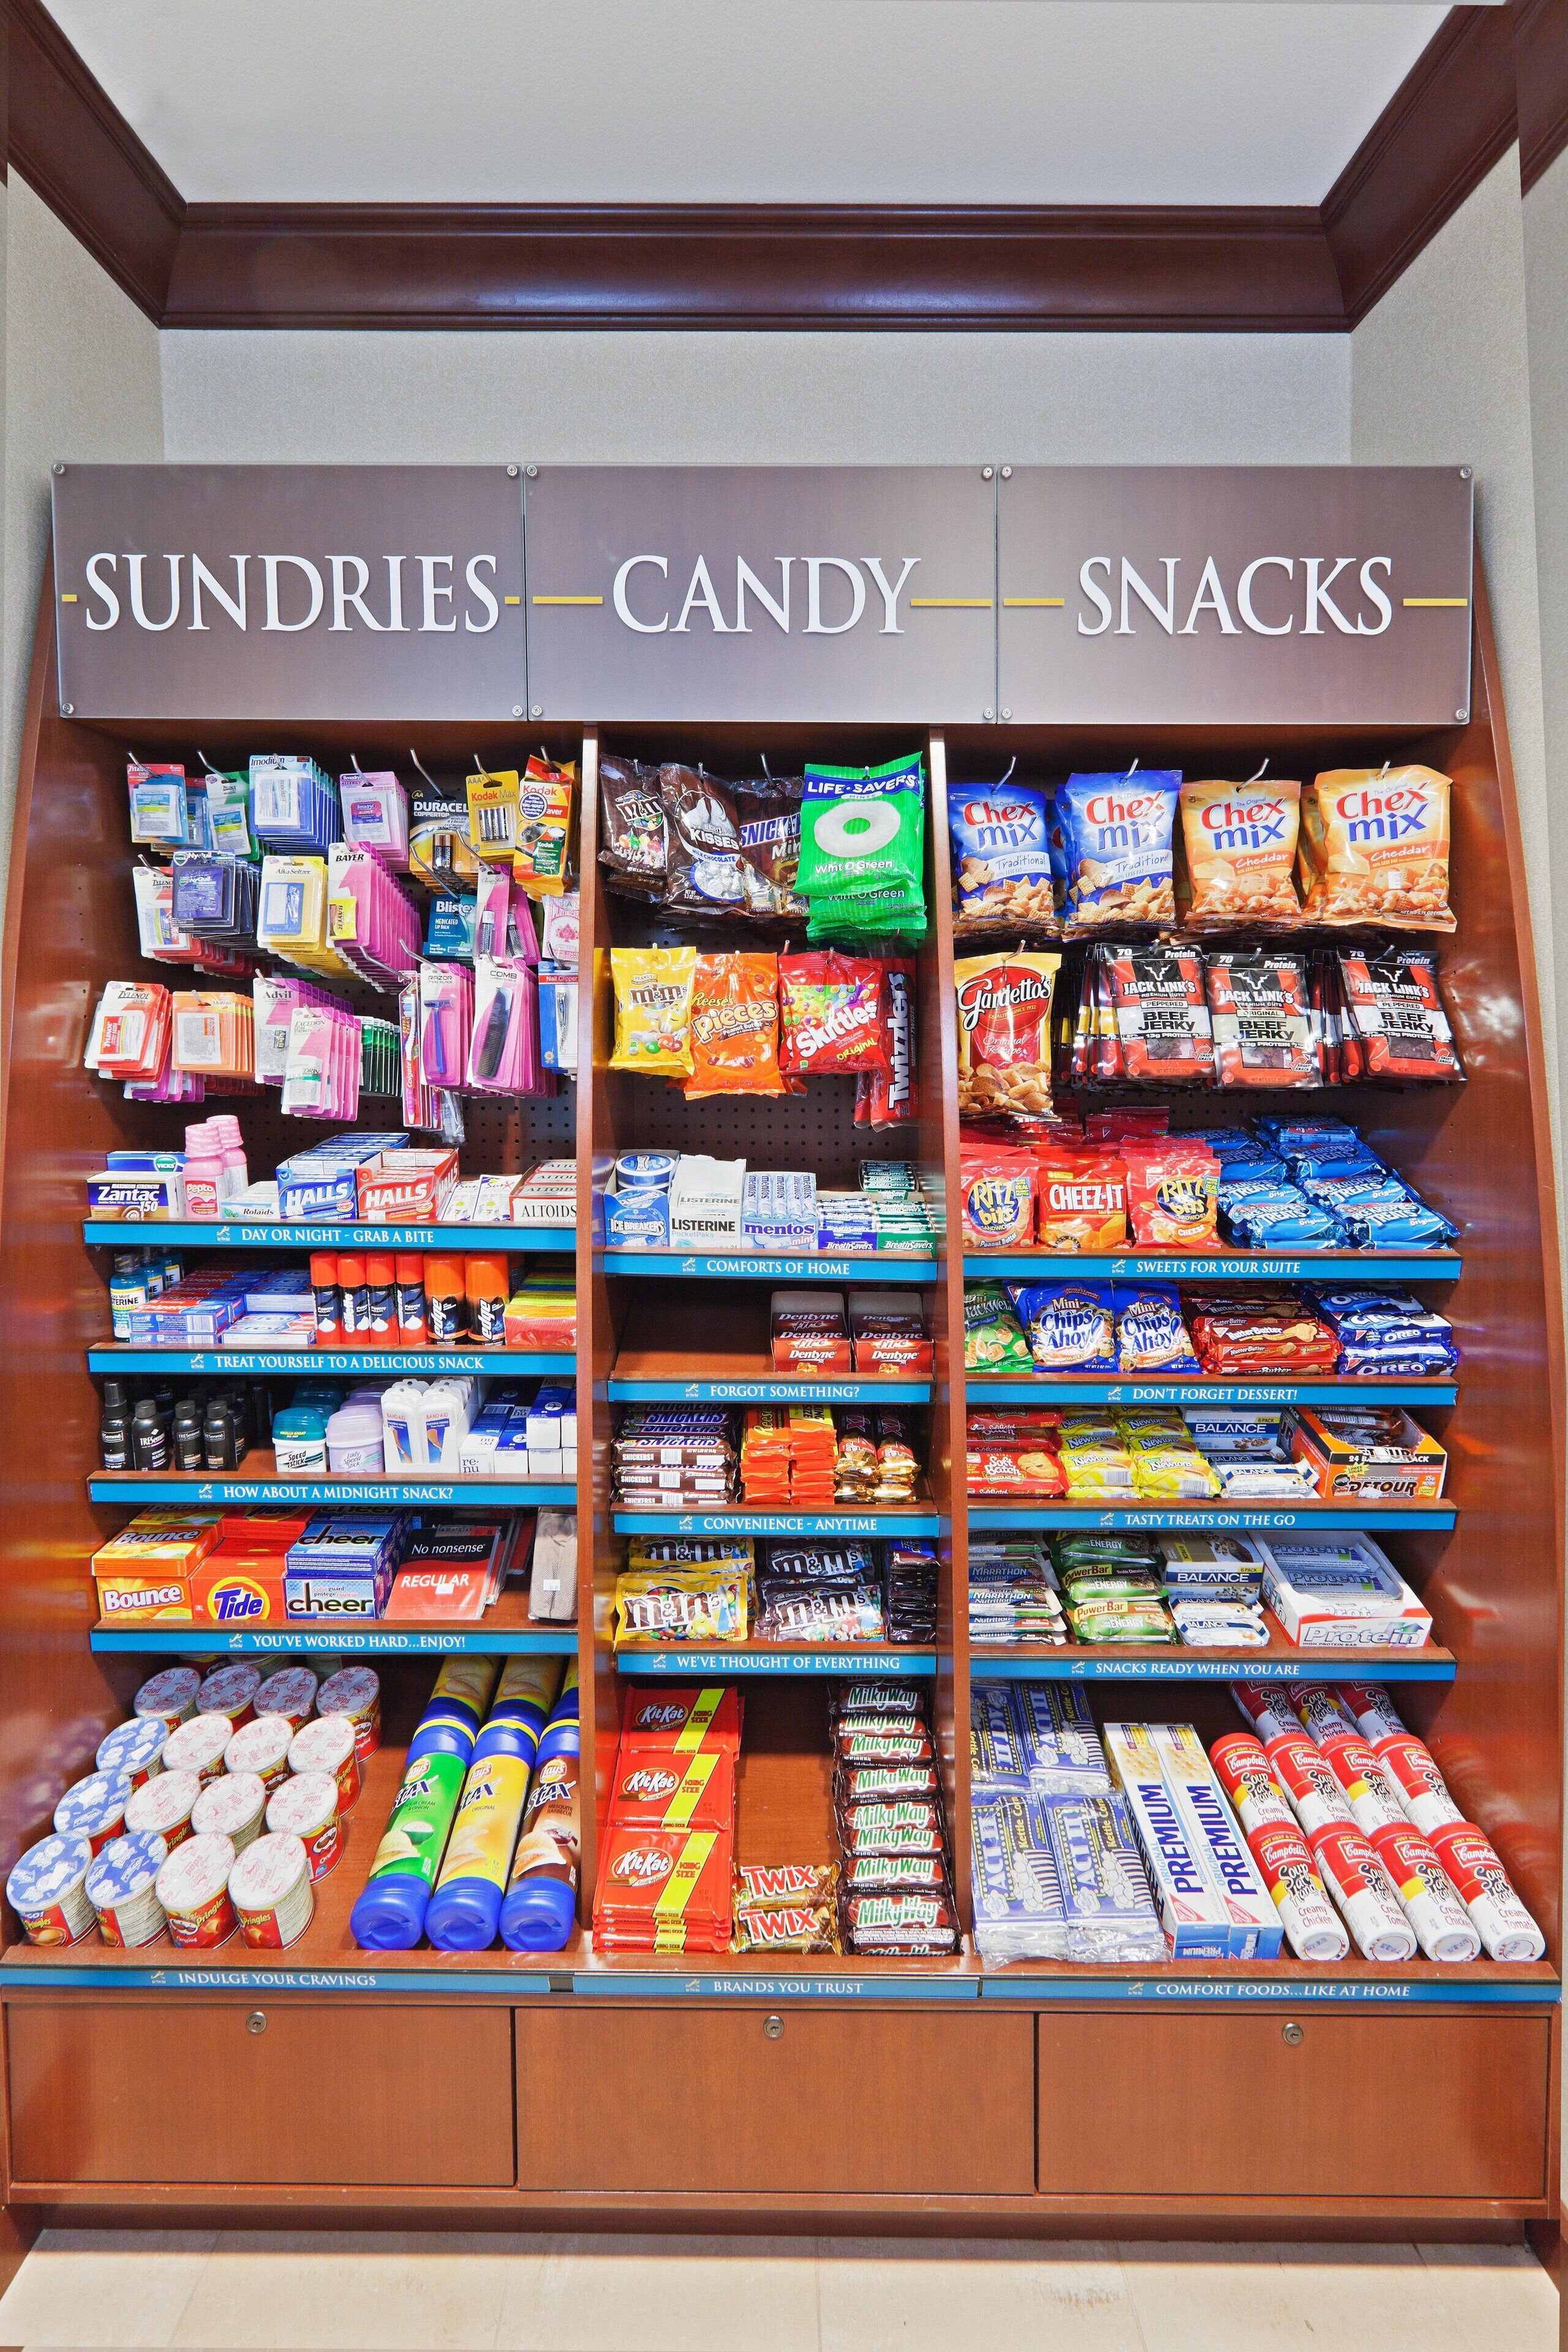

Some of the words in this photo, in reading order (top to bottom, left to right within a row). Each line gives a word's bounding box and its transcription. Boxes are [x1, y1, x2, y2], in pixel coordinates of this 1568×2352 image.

[83, 552, 500, 635] SUNDRIES
[611, 554, 920, 635] CANDY
[1076, 554, 1395, 638] SNACKS
[472, 791, 498, 801] Kodak
[1336, 780, 1432, 820] Chex
[963, 801, 1039, 827] Chex
[1349, 802, 1431, 842] mix
[690, 828, 740, 851] KISSES
[978, 816, 1039, 851] mix
[692, 848, 704, 860] MILK
[705, 853, 736, 862] CHOCOLATE
[1370, 844, 1430, 862] Cheddar
[815, 862, 842, 874] Wint
[854, 859, 893, 870] Green
[995, 854, 1046, 868] Traditional
[436, 900, 475, 916] Blistex
[491, 970, 517, 979] COMB
[263, 990, 293, 999] Advil
[692, 993, 734, 1008] Reese's
[1219, 990, 1251, 1001] JACK
[1253, 990, 1293, 1004] LINK'S
[958, 975, 1052, 1031] Gardetto's
[693, 1000, 777, 1042] pieces
[1144, 1012, 1189, 1020] BEEF
[722, 1023, 744, 1036] Peanut
[744, 1022, 763, 1031] Butter
[1139, 1021, 1195, 1031] JERKY
[97, 1186, 159, 1202] Zantac
[365, 1182, 428, 1208] HALLS
[973, 1180, 1014, 1208] RITZ
[1050, 1184, 1124, 1210] CHEEZ-IT
[140, 1201, 158, 1212] 150
[522, 1205, 576, 1218] ALTOIDS
[979, 1207, 1013, 1225] bits
[1261, 1208, 1308, 1226] TREATS
[1298, 1217, 1328, 1226] Original
[672, 1218, 736, 1231] LISTERINE
[744, 1223, 815, 1235] mentos
[1177, 1225, 1205, 1236] CHEESE
[241, 1229, 268, 1240] DAY
[271, 1229, 293, 1241] OR
[295, 1229, 341, 1242] NIGHT
[353, 1230, 390, 1242] GRAB
[392, 1231, 402, 1242] A
[405, 1231, 434, 1243] BITE
[793, 1235, 815, 1246] mint
[707, 1260, 782, 1273] COMFORTS
[785, 1262, 804, 1273] OF
[809, 1262, 850, 1275] HOME
[1136, 1261, 1186, 1273] SWEETS
[1190, 1262, 1218, 1273] FOR
[1220, 1262, 1259, 1273] YOUR
[1262, 1262, 1300, 1273] SUITE
[1053, 1298, 1080, 1312] Mini
[344, 1292, 355, 1333] Gillette
[431, 1296, 448, 1339] edge
[1041, 1308, 1093, 1332] Chips
[1383, 1329, 1420, 1343] OREO
[789, 1350, 835, 1360] Dentyne
[872, 1351, 918, 1360] Dentyne
[214, 1356, 255, 1368] TREAT
[258, 1356, 324, 1368] YOURSELF
[327, 1356, 347, 1368] TO
[350, 1357, 360, 1368] A
[363, 1357, 435, 1369] DELICIOUS
[439, 1357, 484, 1369] SNACK
[710, 1385, 766, 1396] FORGOT
[770, 1386, 859, 1398] SOMETHING?
[1133, 1388, 1178, 1400] DON'T
[1181, 1389, 1234, 1400] FORGET
[1237, 1389, 1297, 1400] DESSERT!
[1196, 1423, 1266, 1433] BALANCE
[989, 1457, 1013, 1467] Soft
[1150, 1460, 1193, 1471] Newtons
[986, 1465, 1022, 1476] Batch
[224, 1486, 258, 1498] HOW
[262, 1487, 308, 1498] ABOUT
[311, 1487, 321, 1498] A
[324, 1487, 399, 1499] MIDNIGHT
[402, 1487, 453, 1499] SNACK?
[703, 1518, 804, 1530] CONVENIENCE
[815, 1518, 877, 1531] ANYTIME
[1125, 1514, 1164, 1525] TASTY
[1167, 1515, 1214, 1525] TREATS
[1217, 1515, 1240, 1525] ON
[1243, 1515, 1270, 1525] THE
[1273, 1515, 1295, 1526] GO
[411, 1544, 428, 1555] No
[432, 1544, 483, 1555] nonsense
[401, 1574, 469, 1588] REGULAR
[1177, 1573, 1249, 1582] BALANCE
[104, 1585, 182, 1611] Bounce
[214, 1588, 263, 1619] Tide
[288, 1582, 373, 1612] cheer
[1077, 1602, 1125, 1618] PowerBar
[1110, 1616, 1144, 1628] ENERGY
[252, 1635, 302, 1647] YOU'VE
[304, 1635, 365, 1648] WORKED
[1305, 1626, 1421, 1644] Protein
[677, 1656, 716, 1668] WE'VE
[719, 1656, 790, 1668] THOUGHT
[793, 1657, 811, 1668] OF
[815, 1657, 900, 1669] EVERYTHING
[1096, 1663, 1147, 1673] SNACKS
[1151, 1664, 1194, 1674] READY
[1197, 1664, 1239, 1675] WHEN
[1243, 1664, 1272, 1675] YOU
[1274, 1665, 1300, 1675] ARE
[548, 1804, 573, 1812] MESQUITE
[1107, 1821, 1118, 1848] Kettle
[1137, 1784, 1204, 1893] PREMIUM
[1264, 1844, 1310, 1862] Campbell's
[1278, 1863, 1309, 1886] Soup
[1298, 1905, 1327, 1918] Creamy
[1302, 1914, 1333, 1927] Chicken
[1504, 1919, 1536, 1931] Tomato
[179, 1973, 249, 1984] INDULGE
[252, 1973, 295, 1985] YOUR
[299, 1974, 376, 1986] CRAVINGS
[714, 1981, 774, 1992] BRANDS
[778, 1982, 810, 1992] YOU
[815, 1983, 864, 1993] TRUST
[1156, 1984, 1234, 1995] COMFORT
[1339, 1985, 1359, 1996] AT
[1363, 1986, 1411, 1996] HOME
